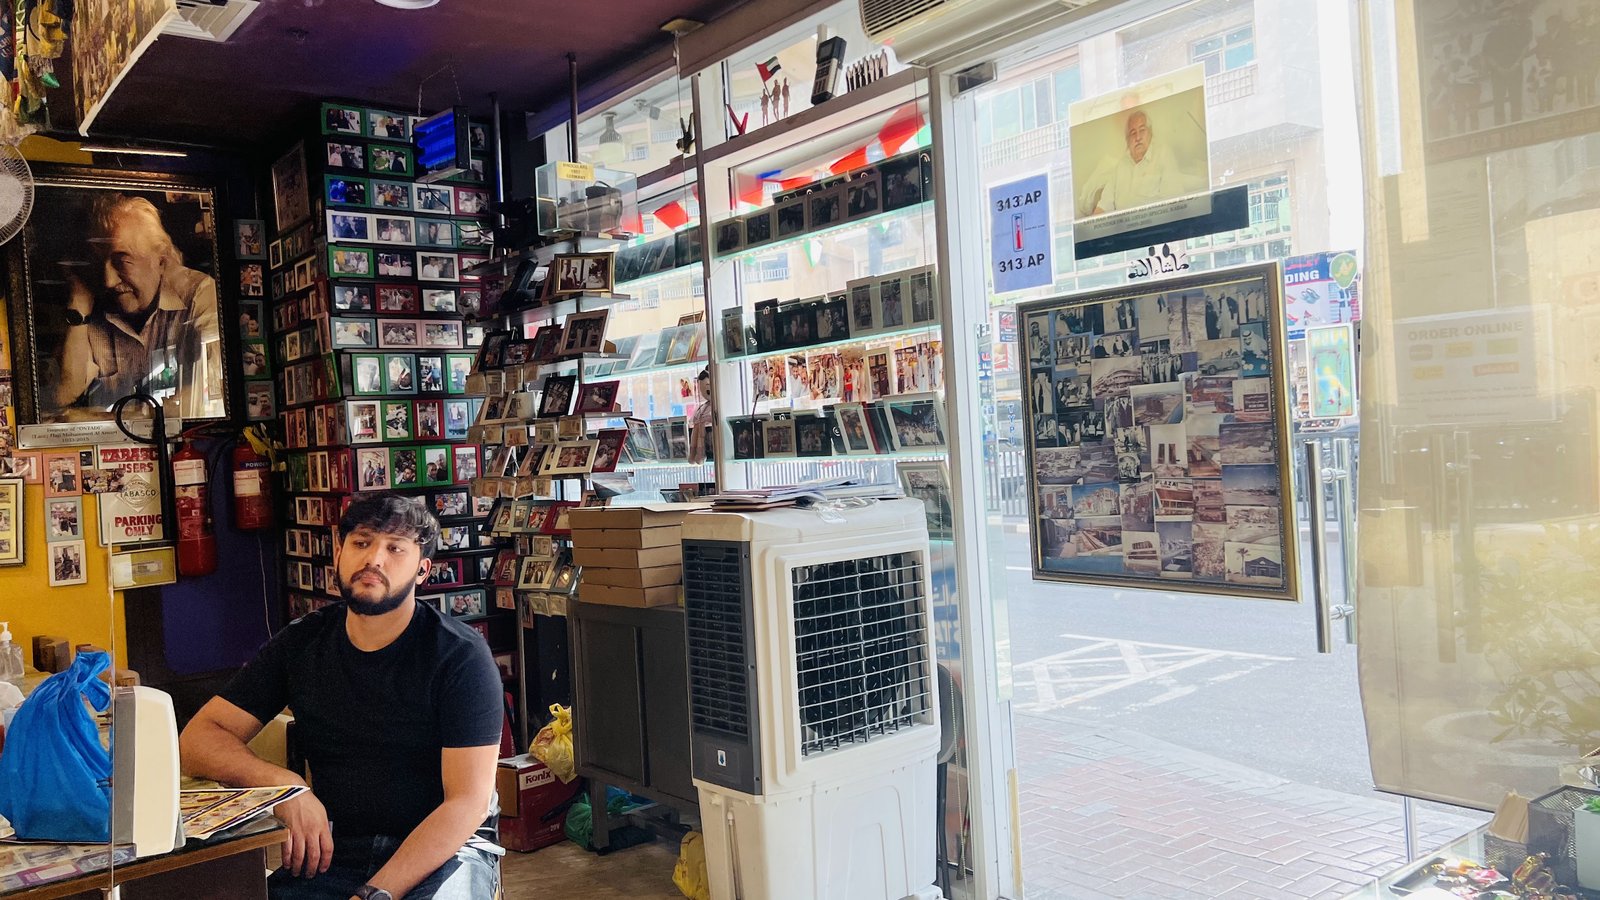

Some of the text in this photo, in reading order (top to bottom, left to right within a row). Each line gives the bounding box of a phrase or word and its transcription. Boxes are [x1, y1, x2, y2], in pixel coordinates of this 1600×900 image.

[999, 253, 1045, 272] 313 AP
[1408, 320, 1523, 341] ORDER ONLINE
[100, 447, 159, 463] TABASC
[118, 462, 154, 473] USERS
[114, 513, 162, 527] PARKING
[125, 525, 154, 537] ONLY
